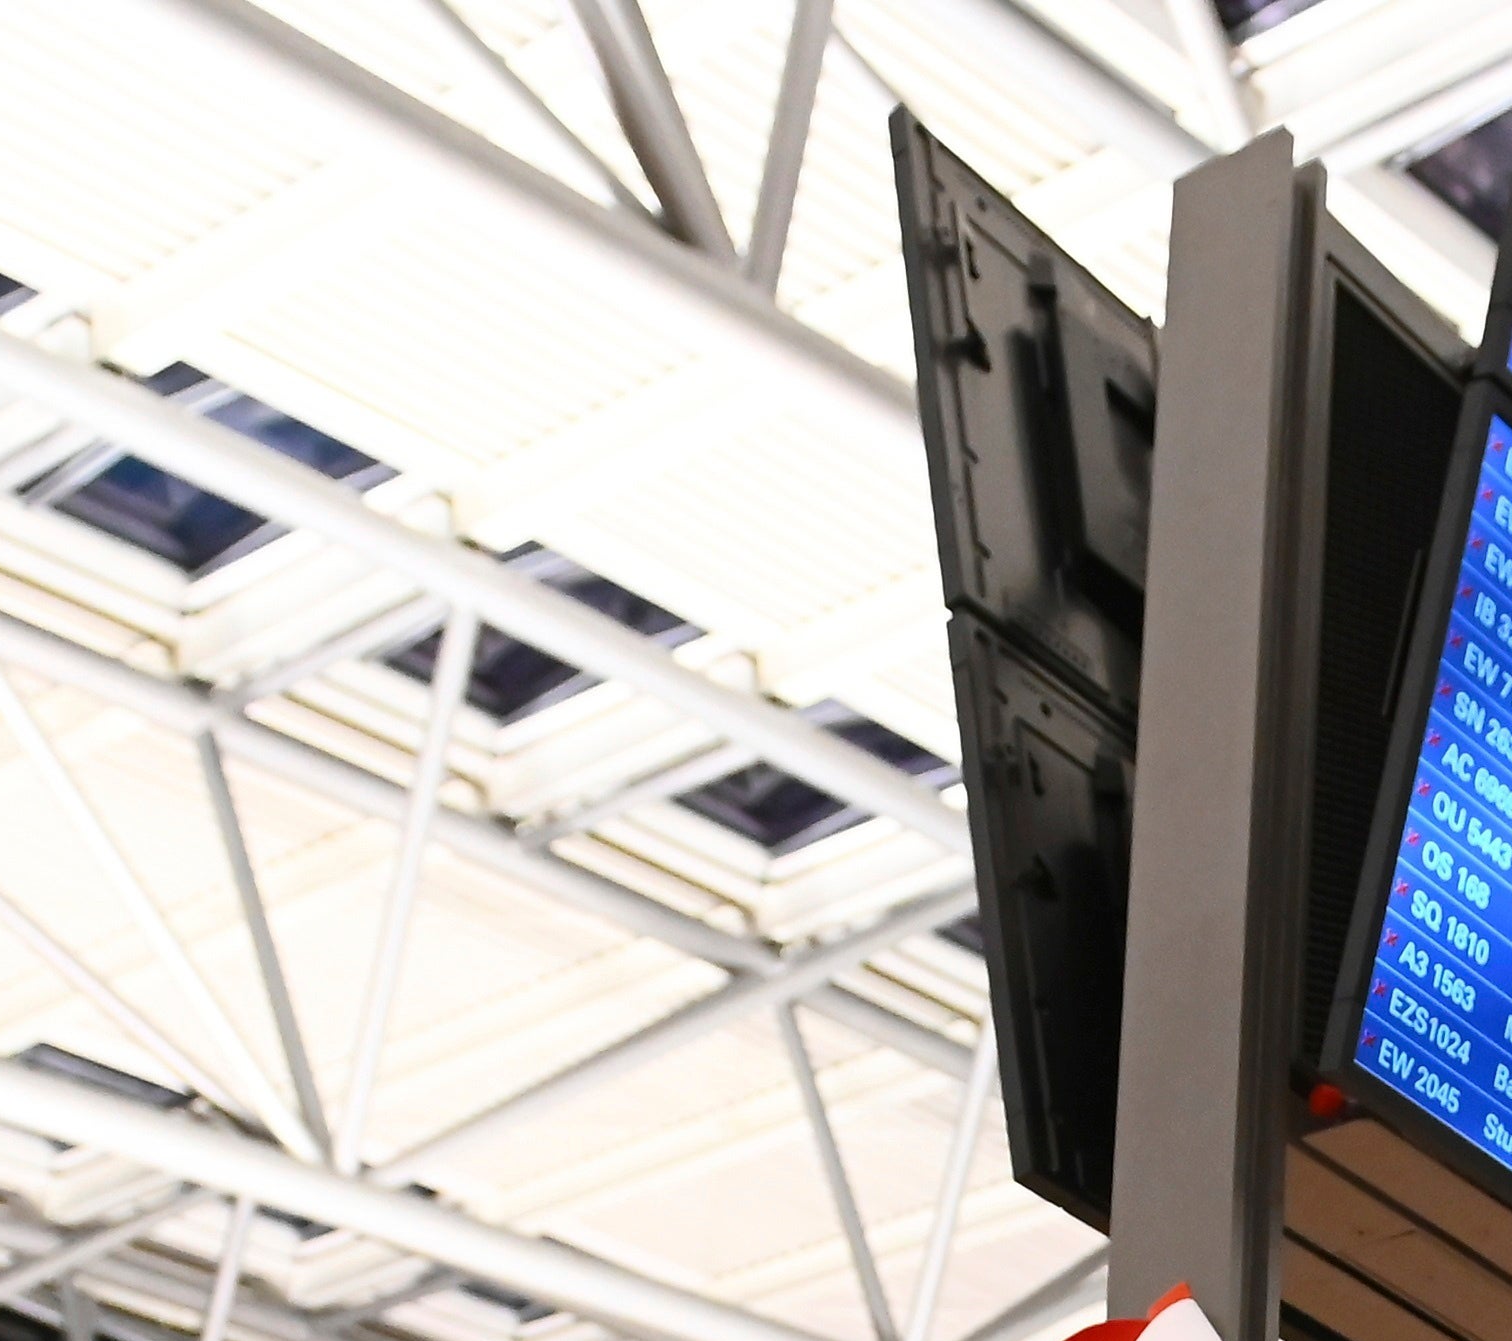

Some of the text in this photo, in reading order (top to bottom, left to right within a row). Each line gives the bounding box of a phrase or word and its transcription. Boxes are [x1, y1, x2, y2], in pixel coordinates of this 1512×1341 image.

[1474, 592, 1496, 627] IB
[1463, 641, 1499, 686] EW
[1453, 691, 1485, 734] SN
[1441, 743, 1474, 782] AC
[1432, 791, 1466, 832] OU
[1467, 817, 1512, 869] 5443
[1422, 840, 1453, 880] OS
[1410, 889, 1442, 932] SQ
[1446, 915, 1489, 964] 1810
[1398, 941, 1429, 977] A3
[1433, 963, 1475, 1011] 1563
[1389, 987, 1470, 1064] EZS1024
[1378, 1038, 1414, 1079] EW
[1414, 1065, 1460, 1113] 2045
